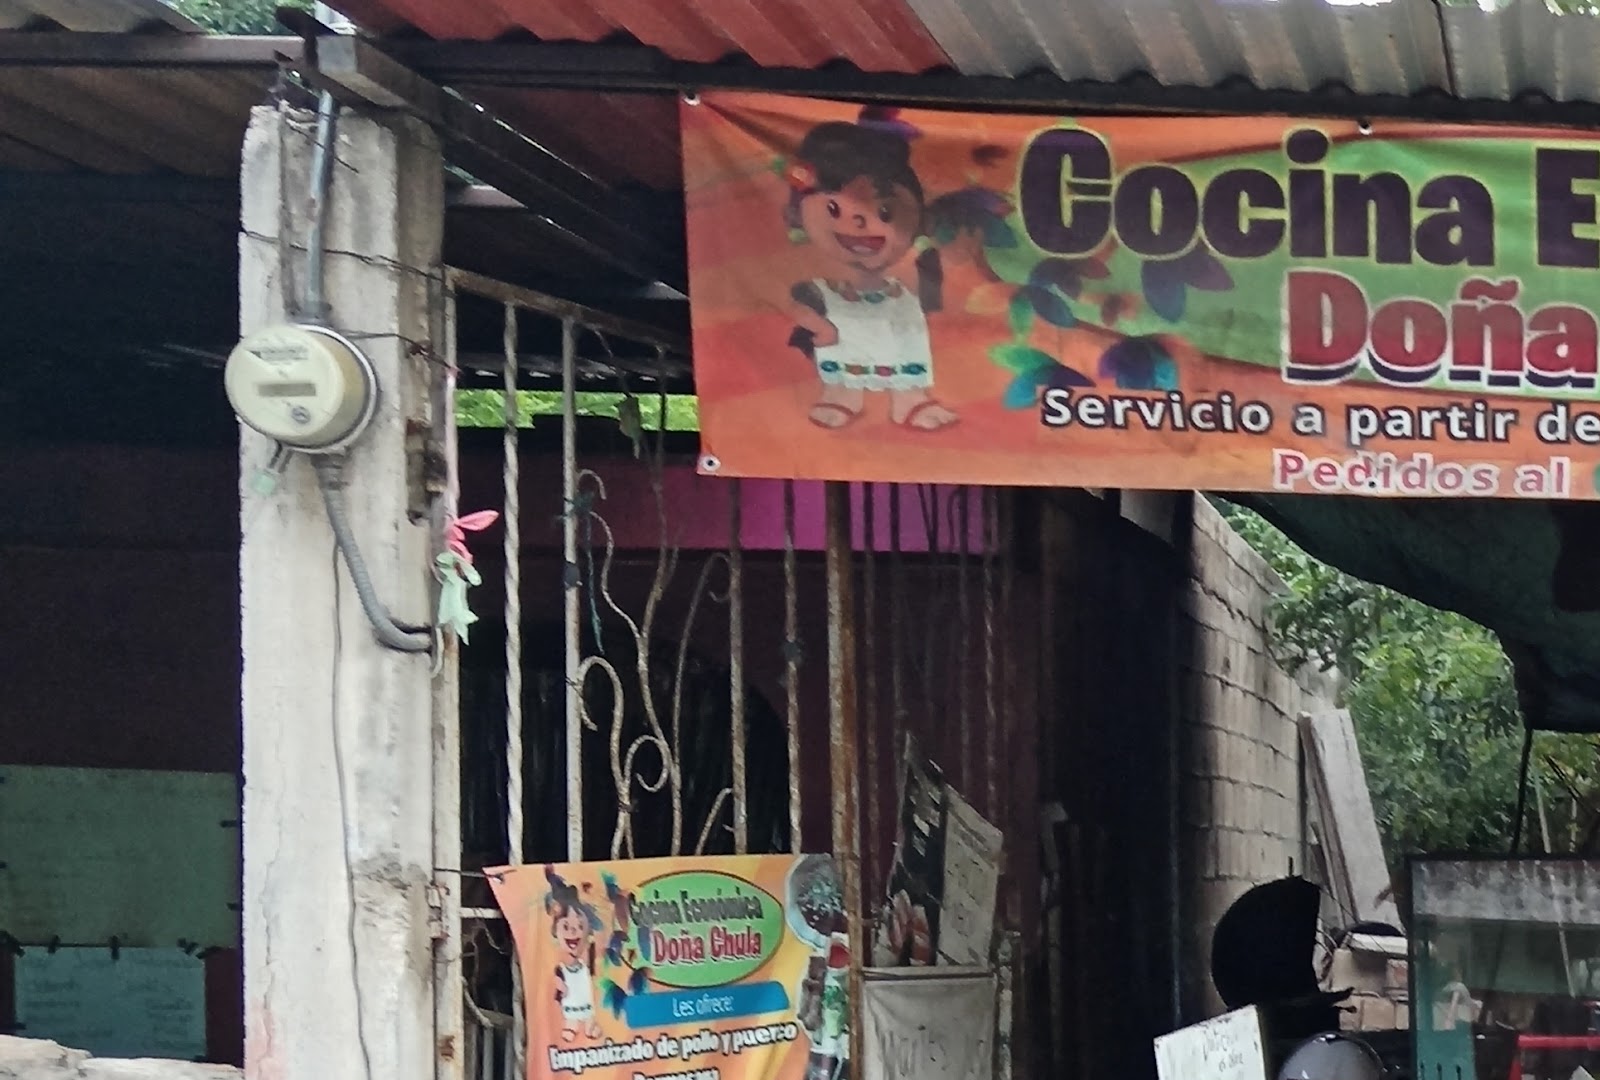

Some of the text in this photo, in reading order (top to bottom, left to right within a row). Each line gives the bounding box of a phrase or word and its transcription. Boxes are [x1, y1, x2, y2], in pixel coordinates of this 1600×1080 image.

[1016, 125, 1497, 266] Cocina
[1041, 389, 1272, 434] Servicio
[1295, 407, 1326, 437] a
[1350, 396, 1517, 446] partir
[1272, 449, 1495, 494] Pedidos
[1513, 456, 1569, 495] al
[650, 924, 762, 967] Doña Chula
[671, 994, 695, 1018] Les
[547, 1037, 656, 1075] Empanizado
[655, 1032, 680, 1059] de
[680, 1027, 721, 1060] pollo
